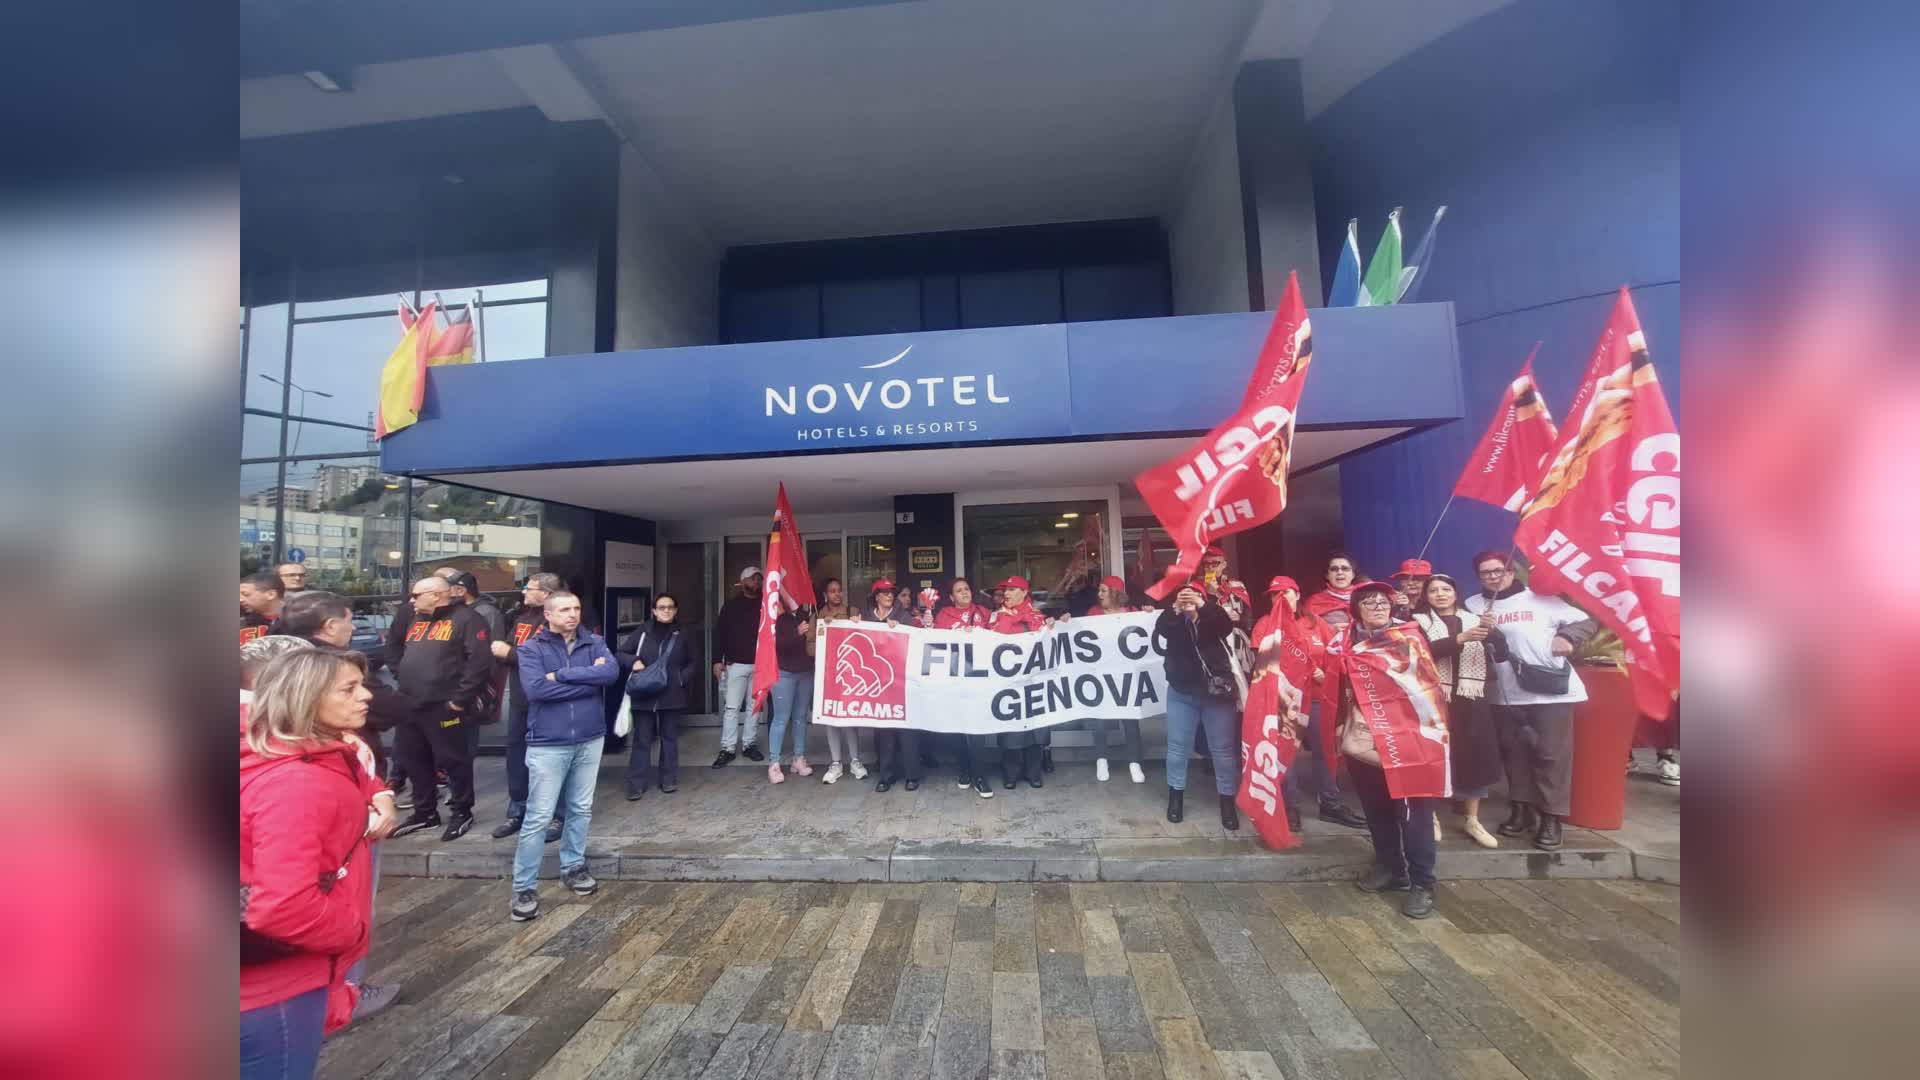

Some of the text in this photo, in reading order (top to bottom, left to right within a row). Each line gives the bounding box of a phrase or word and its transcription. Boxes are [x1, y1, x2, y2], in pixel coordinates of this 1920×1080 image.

[765, 374, 1010, 416] NOVOTEL
[797, 420, 978, 440] HOTELS & RESORTS
[920, 629, 1102, 678] FILCAMS
[822, 699, 906, 720] FILCAMS
[990, 670, 1159, 722] GENOVA
